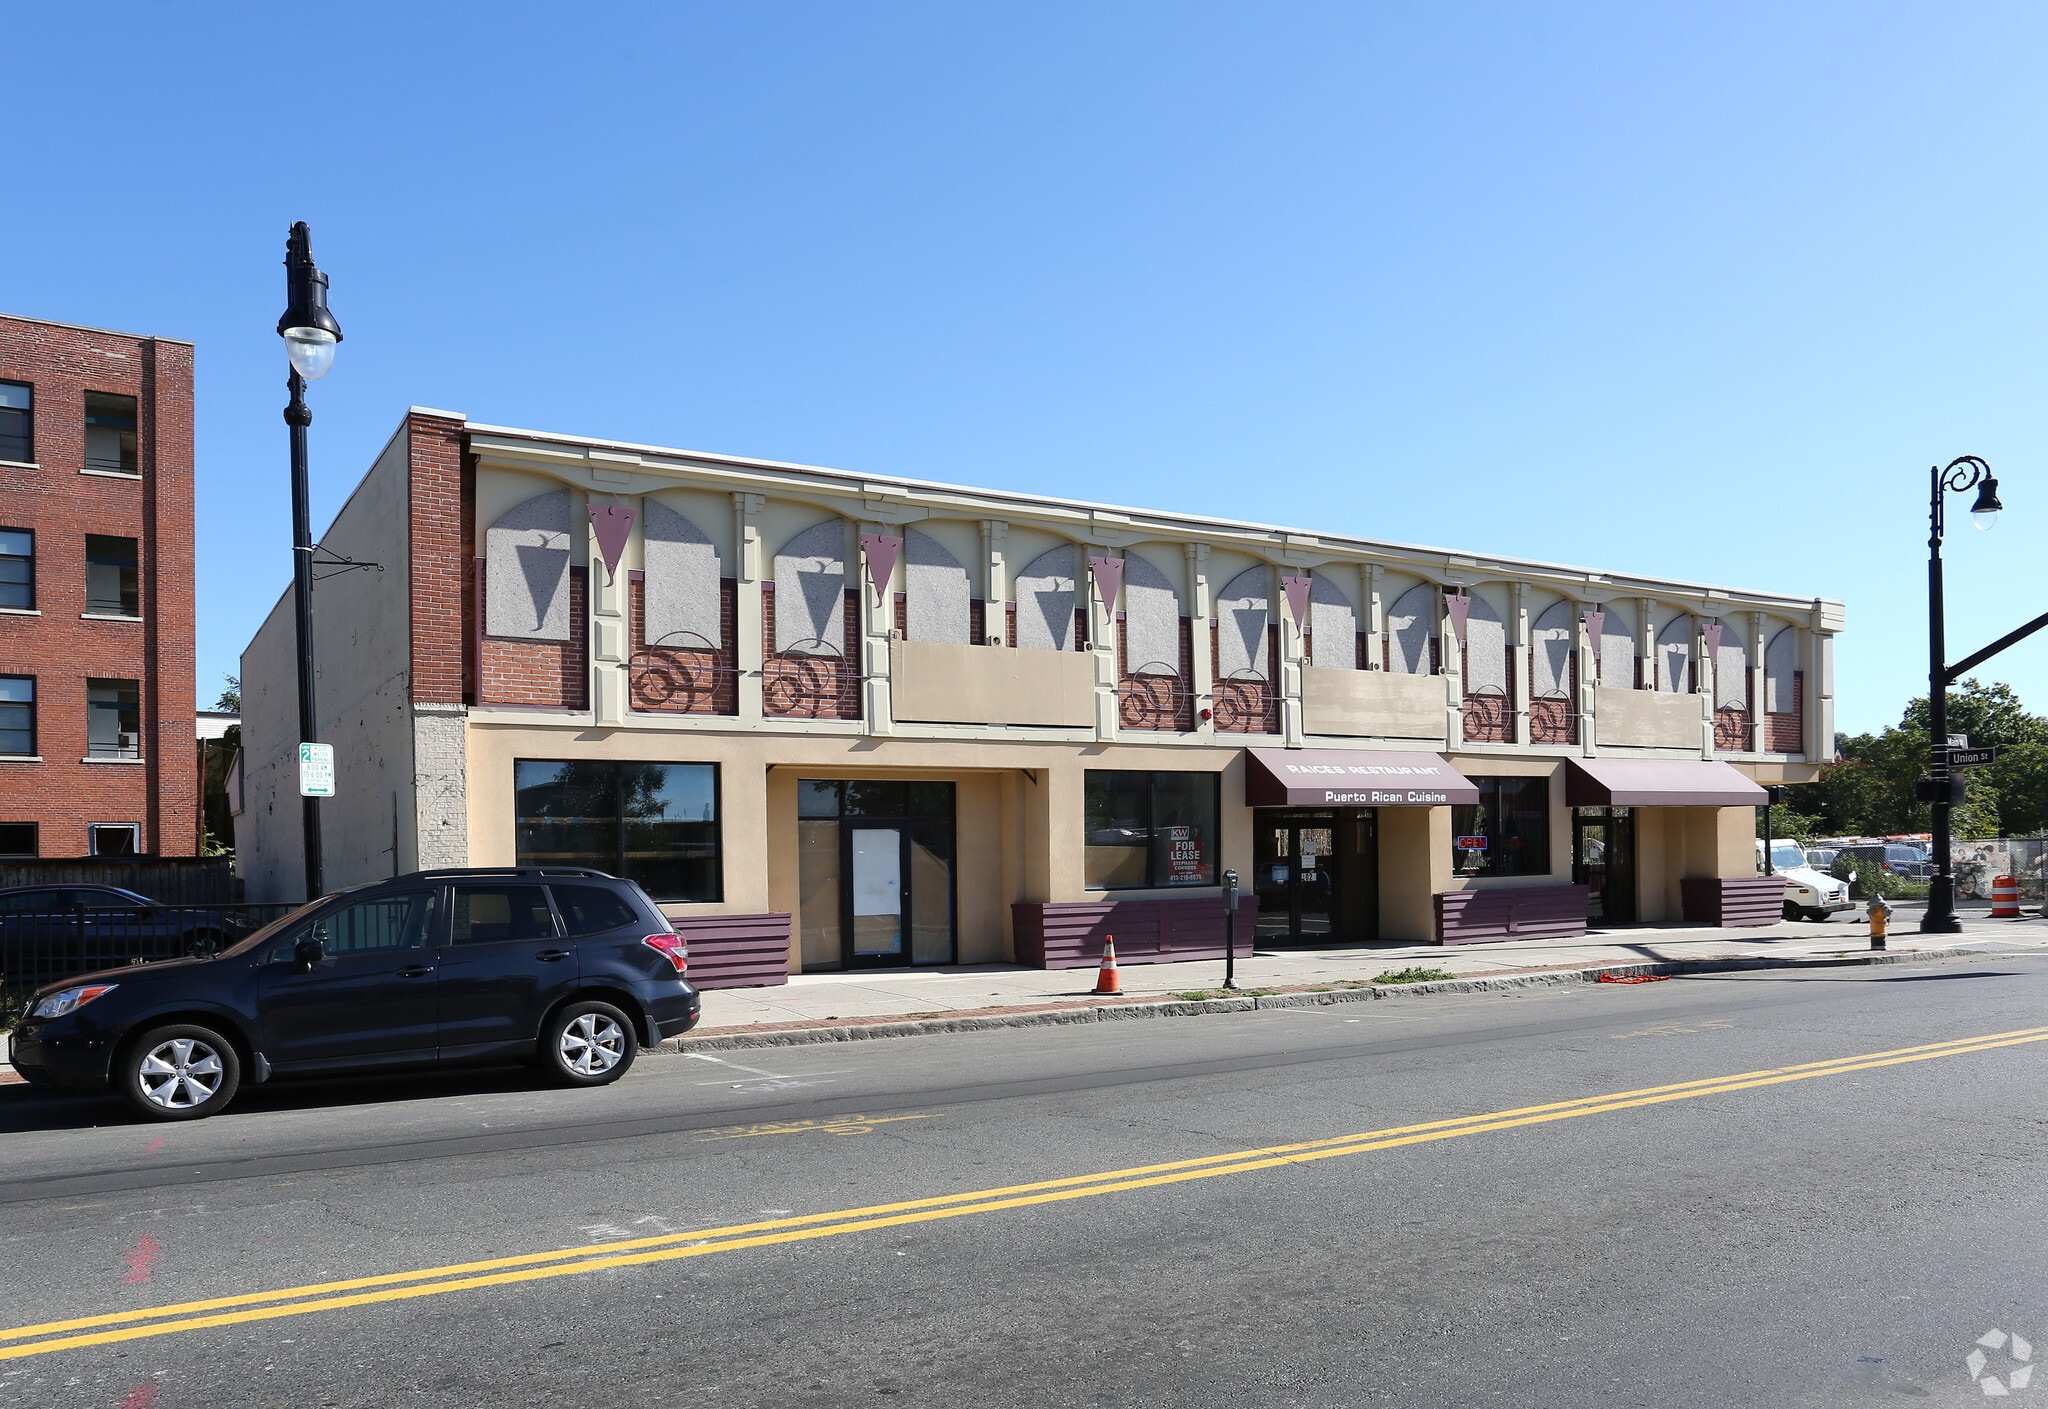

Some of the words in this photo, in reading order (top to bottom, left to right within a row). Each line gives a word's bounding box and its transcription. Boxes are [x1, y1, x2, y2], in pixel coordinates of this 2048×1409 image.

[302, 749, 310, 763] 2
[1953, 753, 1979, 763] Union
[1286, 764, 1346, 775] RAICES
[1347, 766, 1441, 776] RESTAURANT
[1325, 791, 1367, 802] Puerto
[1371, 791, 1403, 802] Rican
[1407, 791, 1447, 802] Cuisine
[1172, 829, 1188, 837] KW
[1175, 841, 1195, 850] FOR
[1459, 838, 1486, 848] OPEN
[1170, 851, 1200, 860] LEASE
